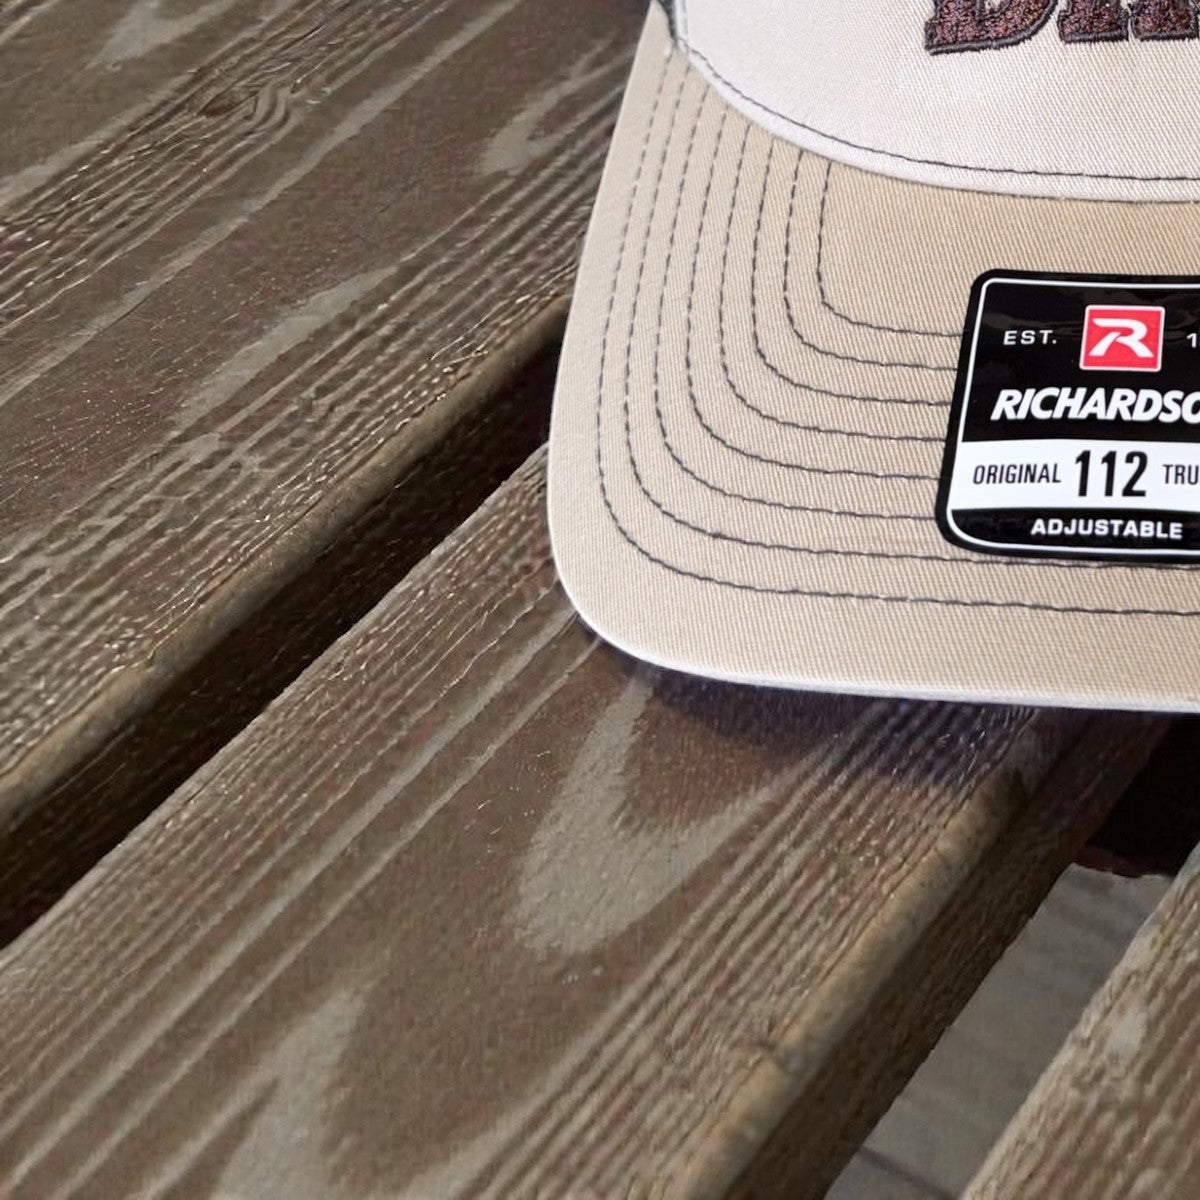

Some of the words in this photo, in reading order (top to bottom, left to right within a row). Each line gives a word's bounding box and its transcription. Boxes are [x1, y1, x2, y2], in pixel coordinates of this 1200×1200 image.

[1002, 329, 1058, 346] EST.
[972, 462, 1062, 486] ORIGINAL
[1074, 448, 1149, 498] 112
[1030, 517, 1184, 540] ADJUSTABLE
